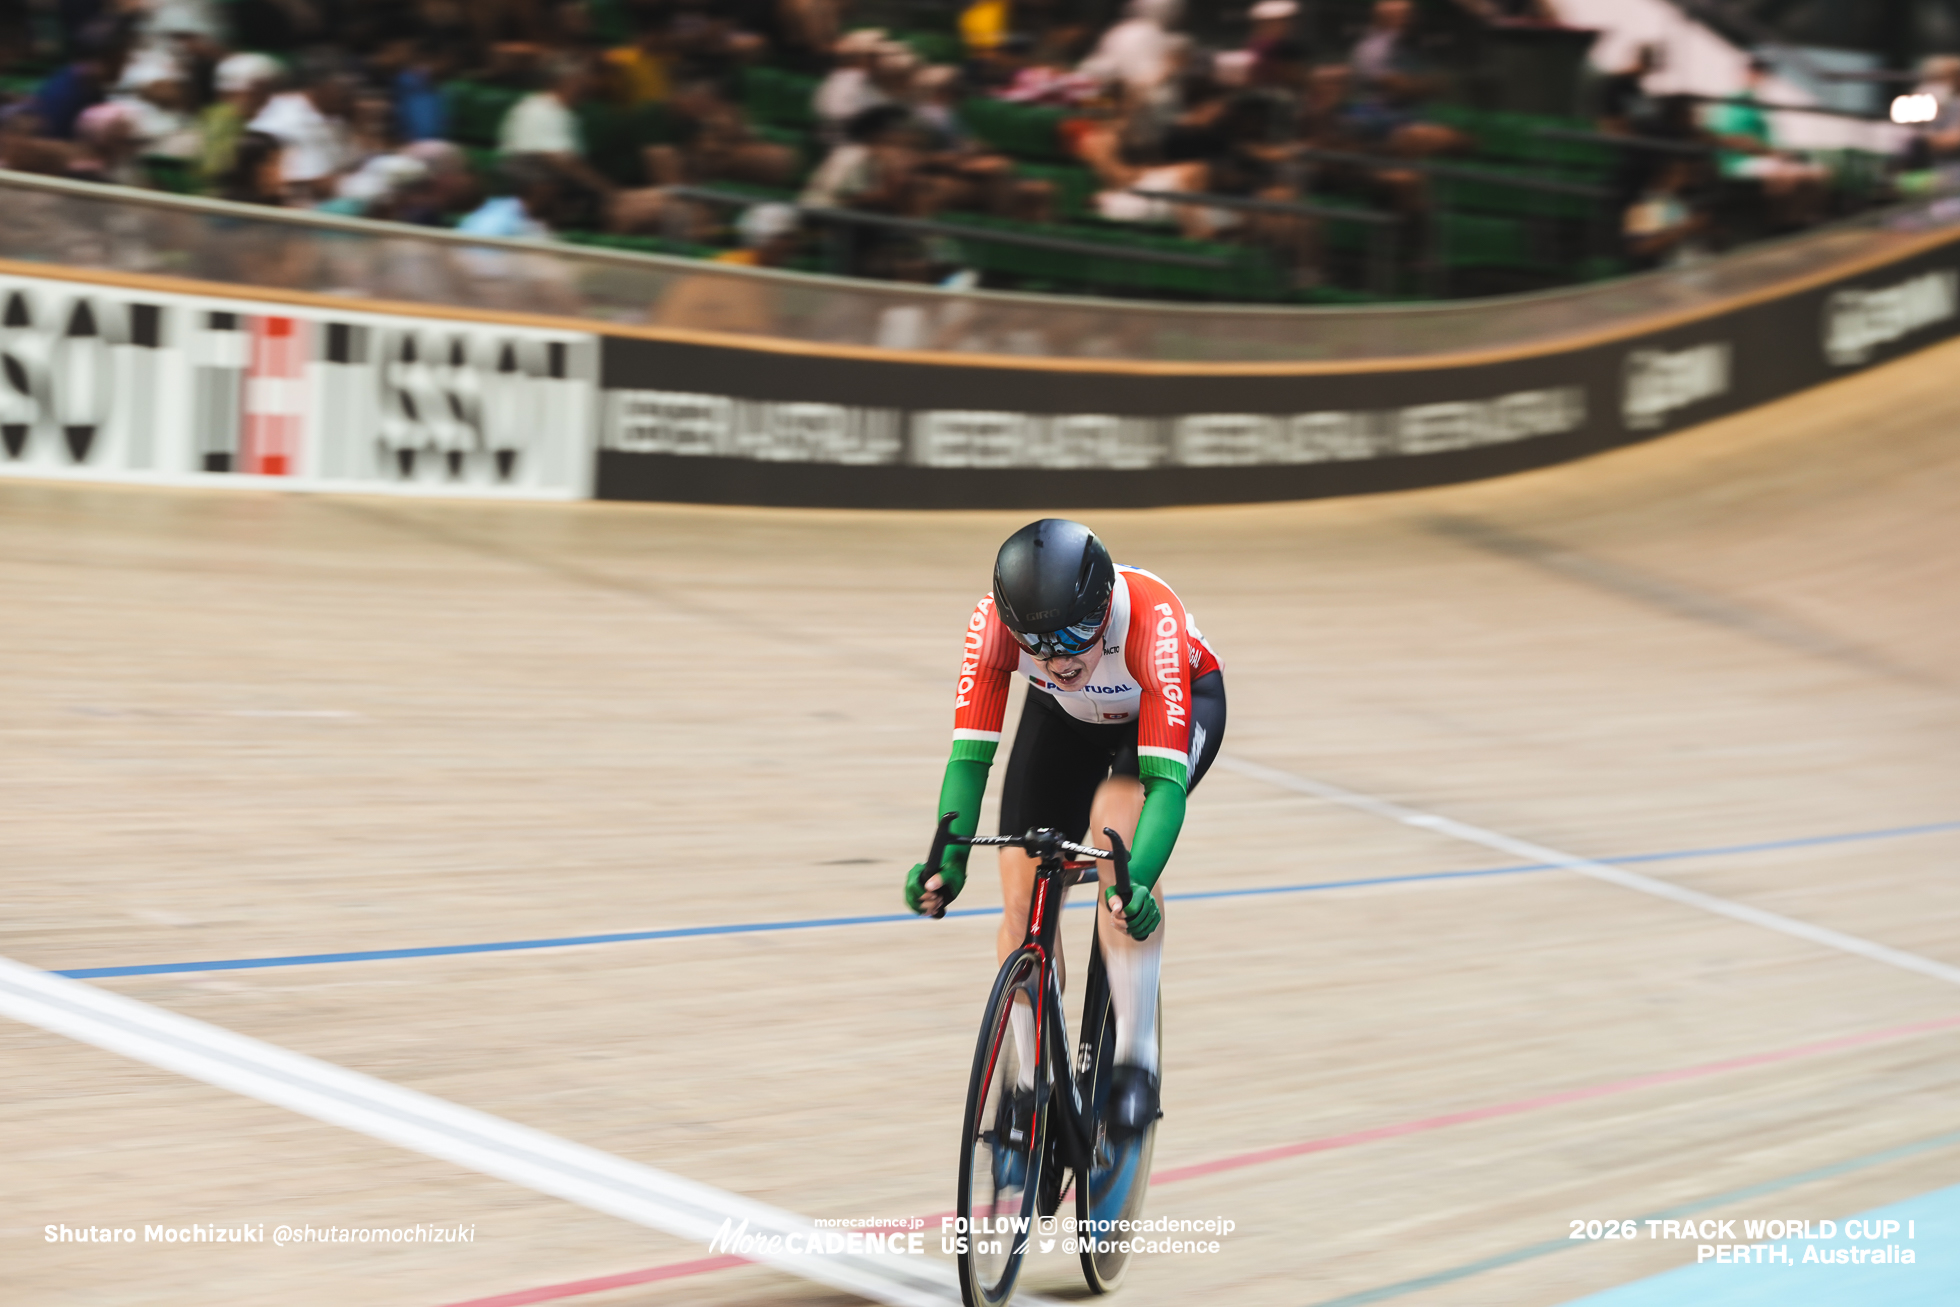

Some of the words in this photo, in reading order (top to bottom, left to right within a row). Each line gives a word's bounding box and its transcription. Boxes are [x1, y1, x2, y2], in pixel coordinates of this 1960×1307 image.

[1026, 608, 1060, 621] GIRO
[1154, 603, 1186, 727] PORTUGAL
[1047, 682, 1132, 694] PTUGAL
